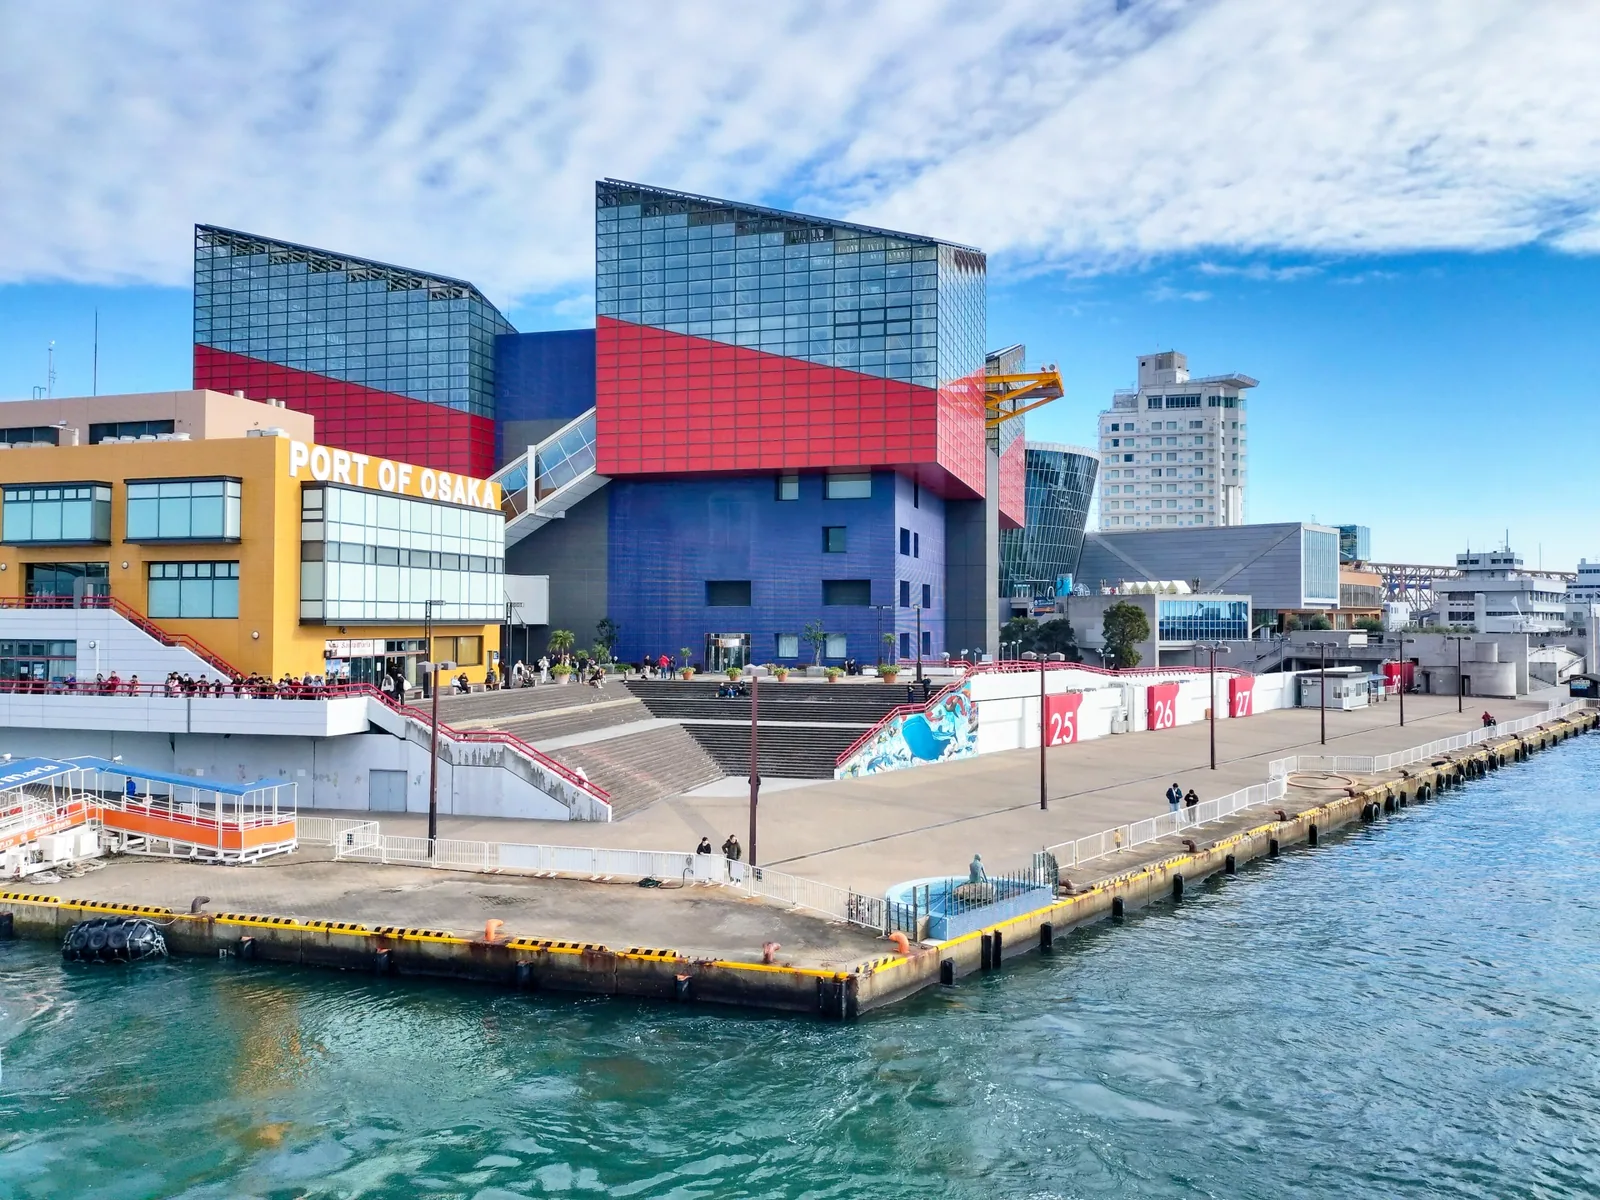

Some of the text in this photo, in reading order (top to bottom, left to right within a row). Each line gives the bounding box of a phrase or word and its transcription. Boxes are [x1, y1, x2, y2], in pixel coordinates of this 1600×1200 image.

[289, 440, 496, 509] PORT OF OSAKA
[1155, 699, 1173, 729] 26
[1236, 690, 1251, 717] 27
[1051, 711, 1074, 746] 25
